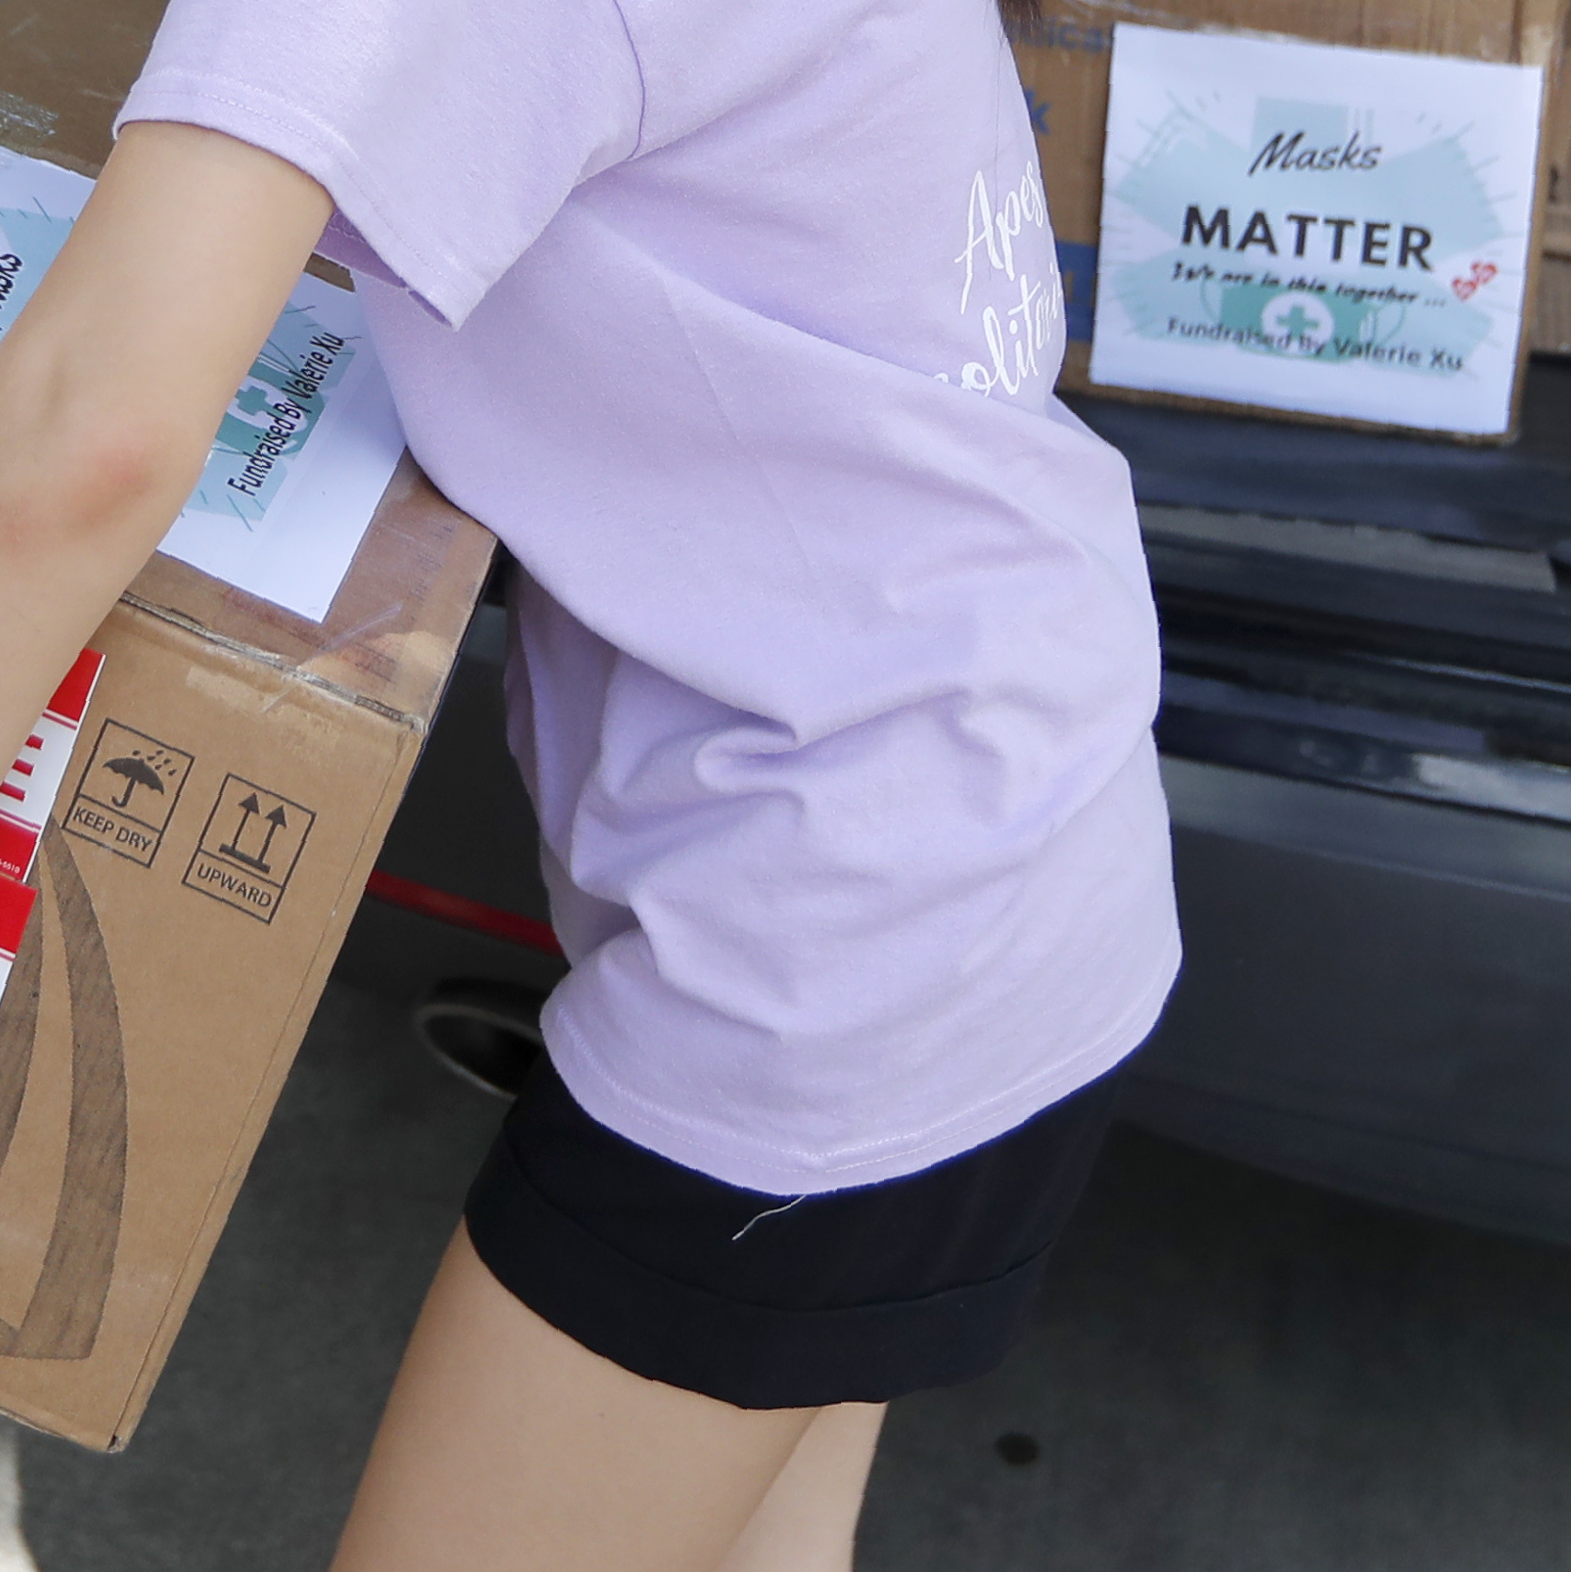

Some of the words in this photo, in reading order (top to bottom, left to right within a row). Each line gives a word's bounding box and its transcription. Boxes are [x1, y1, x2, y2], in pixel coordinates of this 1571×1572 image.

[1248, 130, 1382, 177] Masks
[1182, 204, 1434, 273] MATTER
[1287, 275, 1327, 293] this
[1335, 282, 1420, 305] together
[309, 332, 346, 357] Xu
[1168, 317, 1292, 351] Fundraised
[1299, 331, 1326, 357] By
[1334, 338, 1423, 367] Valerie
[1429, 347, 1465, 372] Xu
[281, 354, 334, 400] Valerie
[272, 397, 313, 422] By
[227, 411, 298, 497] Fundraised
[72, 806, 115, 834] KEEP
[116, 829, 153, 853] DRY
[196, 862, 273, 908] UPWARD
